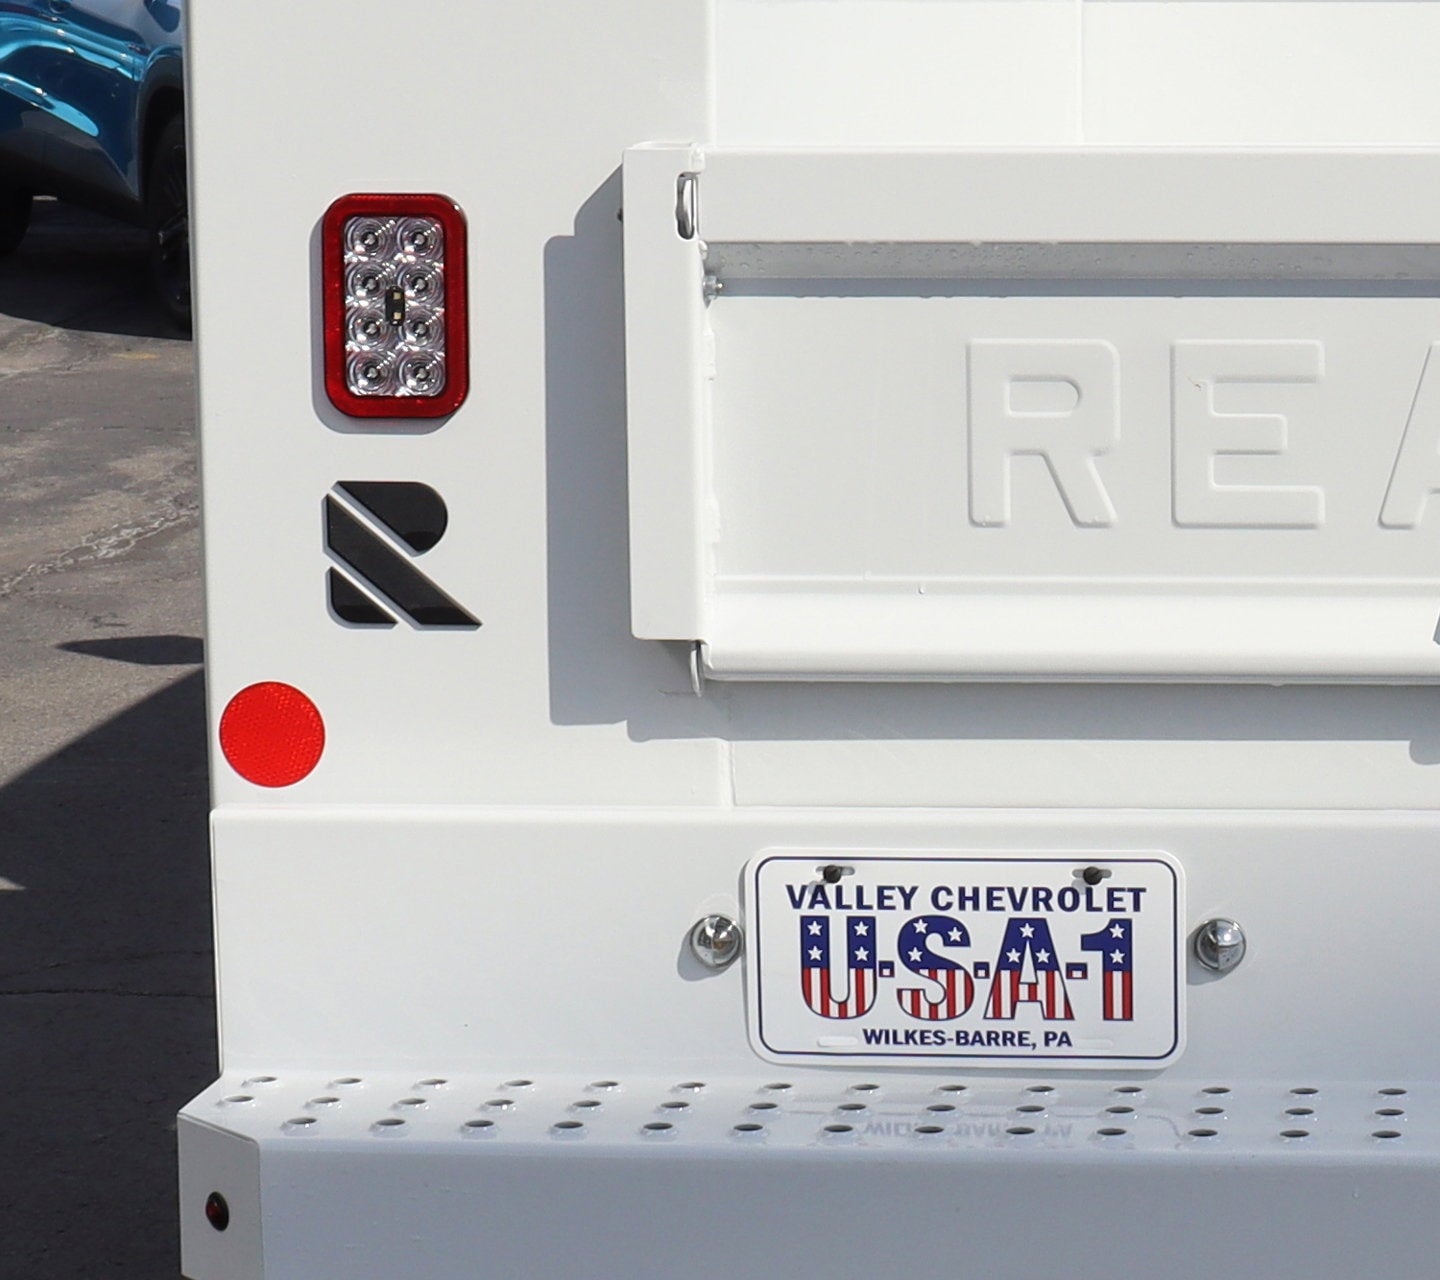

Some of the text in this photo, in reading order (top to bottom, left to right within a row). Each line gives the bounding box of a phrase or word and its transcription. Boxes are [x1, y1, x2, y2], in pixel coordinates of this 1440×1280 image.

[786, 884, 1147, 913] VALLEY CHEVROLET
[863, 1028, 1073, 1051] WILKES-BARRE, PA
